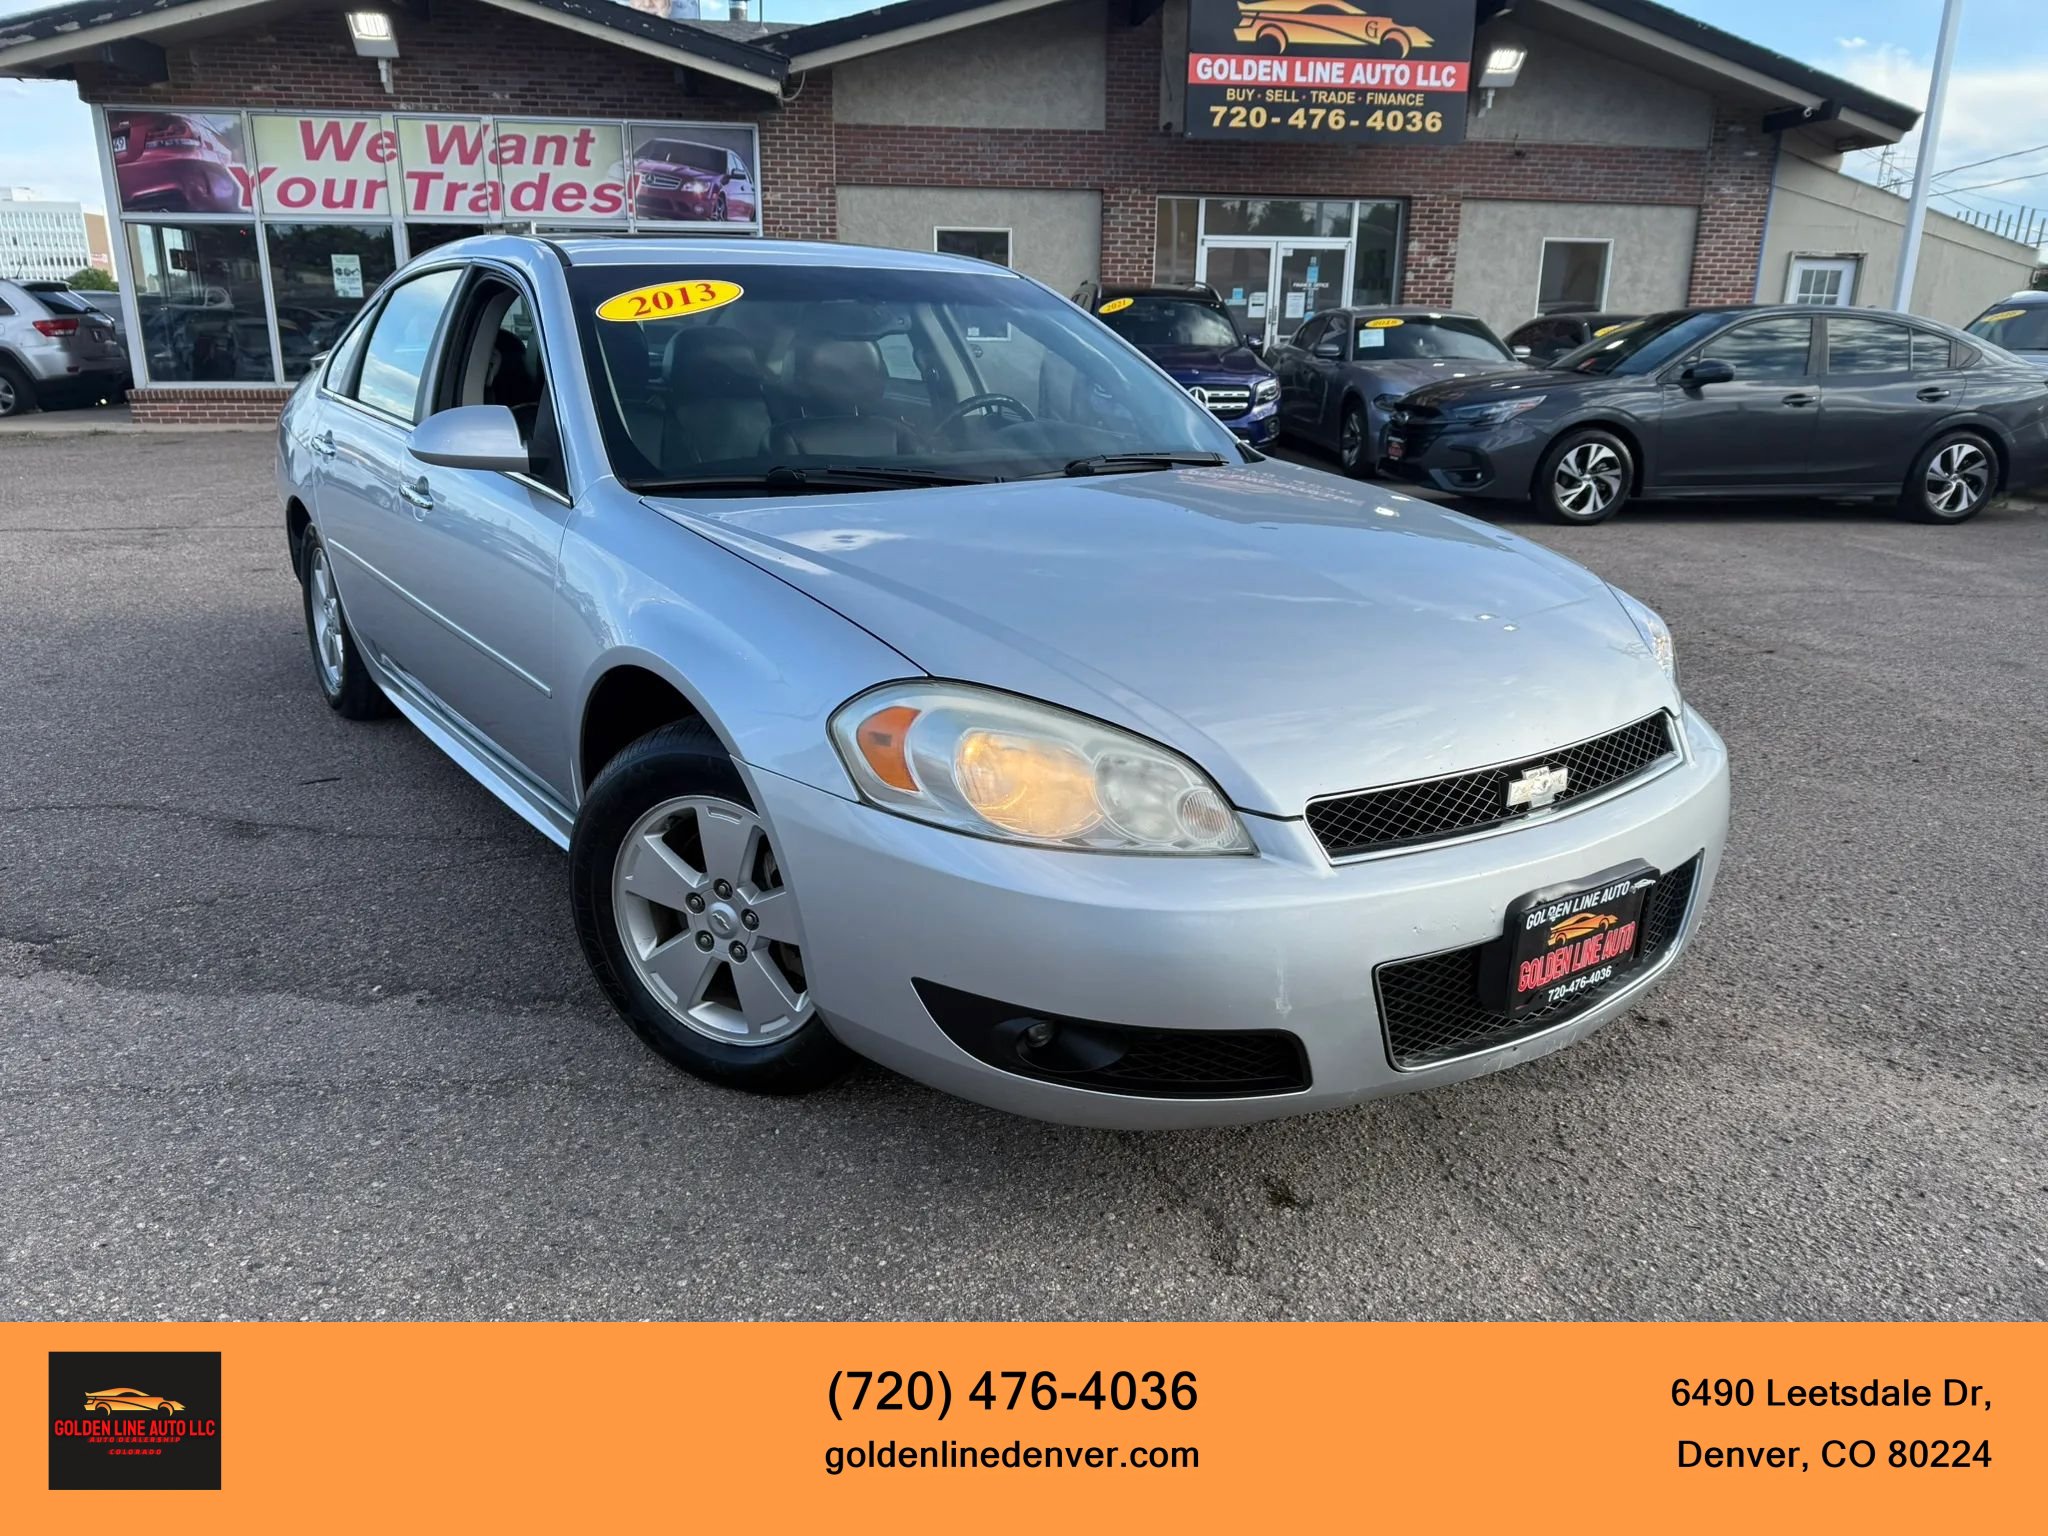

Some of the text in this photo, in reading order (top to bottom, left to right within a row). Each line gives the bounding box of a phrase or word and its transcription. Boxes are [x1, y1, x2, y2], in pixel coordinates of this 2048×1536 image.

[1196, 57, 1456, 87] GOLDEN LINE AUTO LLC
[1226, 88, 1424, 106] BUY SELL TRADE FINANCE
[299, 119, 596, 167] We Want
[227, 166, 641, 214] Your Trades!
[628, 282, 717, 316] 2013
[1526, 881, 1631, 930] GOLDEN LINE AUTO
[1518, 920, 1637, 993] GOLDEN LINE AUTO
[1548, 965, 1613, 1003] 720-476-4036
